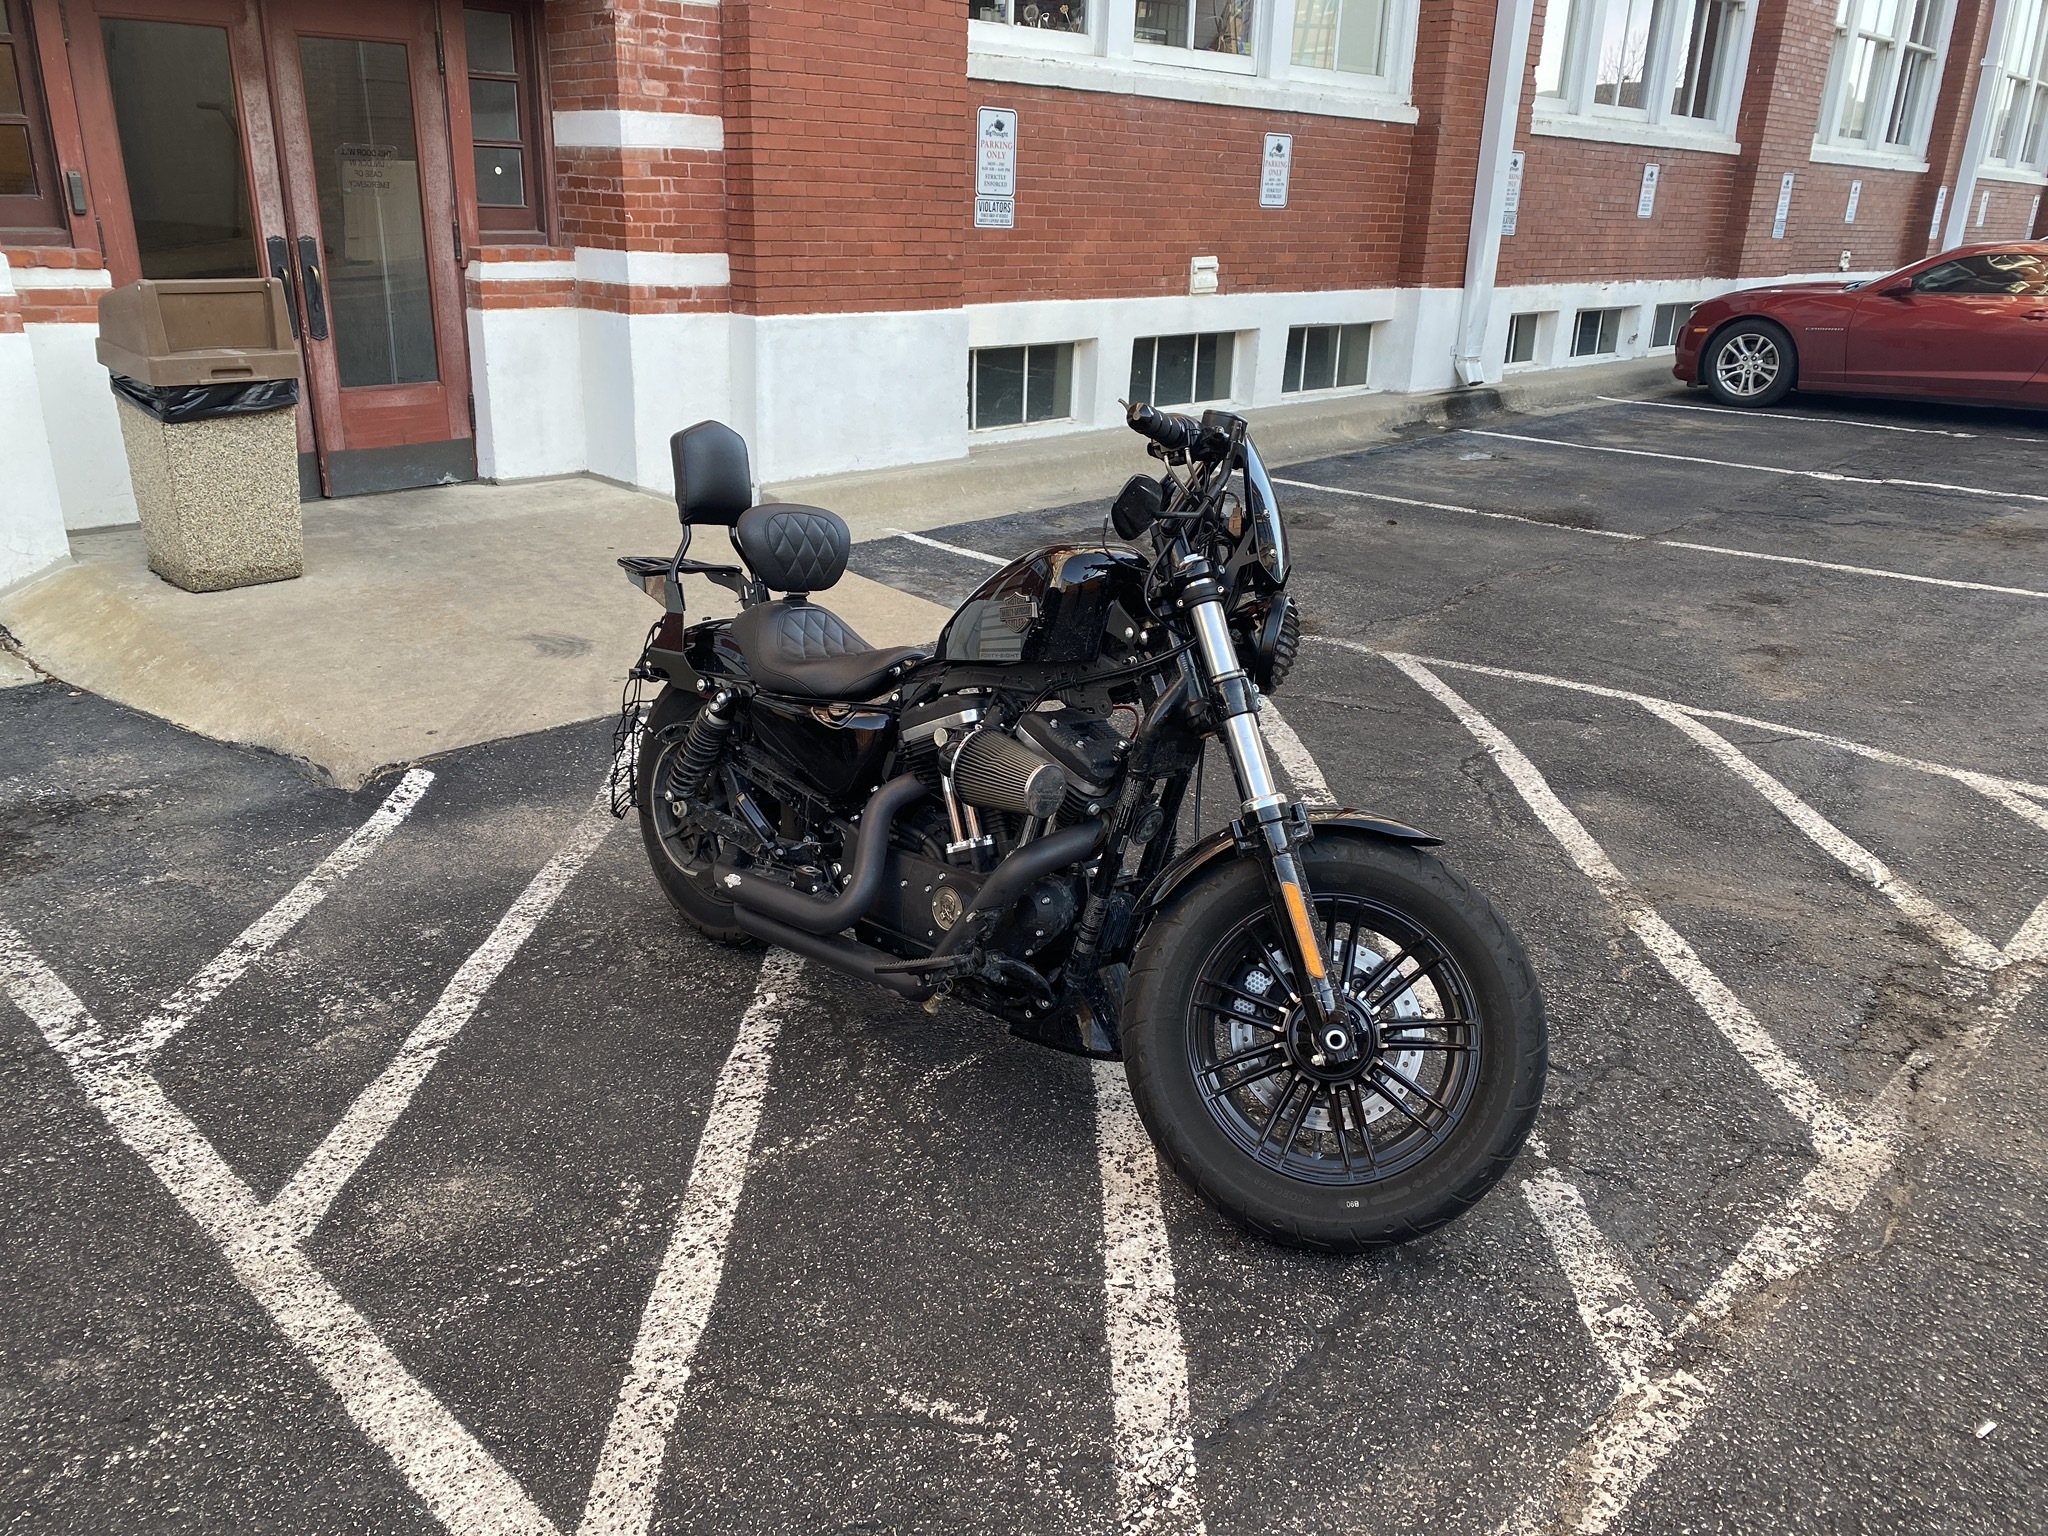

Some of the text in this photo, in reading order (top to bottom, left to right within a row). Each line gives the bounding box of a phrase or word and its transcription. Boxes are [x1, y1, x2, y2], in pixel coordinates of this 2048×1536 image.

[980, 139, 1013, 150] PARKING
[986, 150, 1006, 160] ONLY
[1265, 160, 1287, 168] PARKING
[978, 201, 1012, 213] VIOLATORS
[1254, 1176, 1312, 1204] SCORCHER
